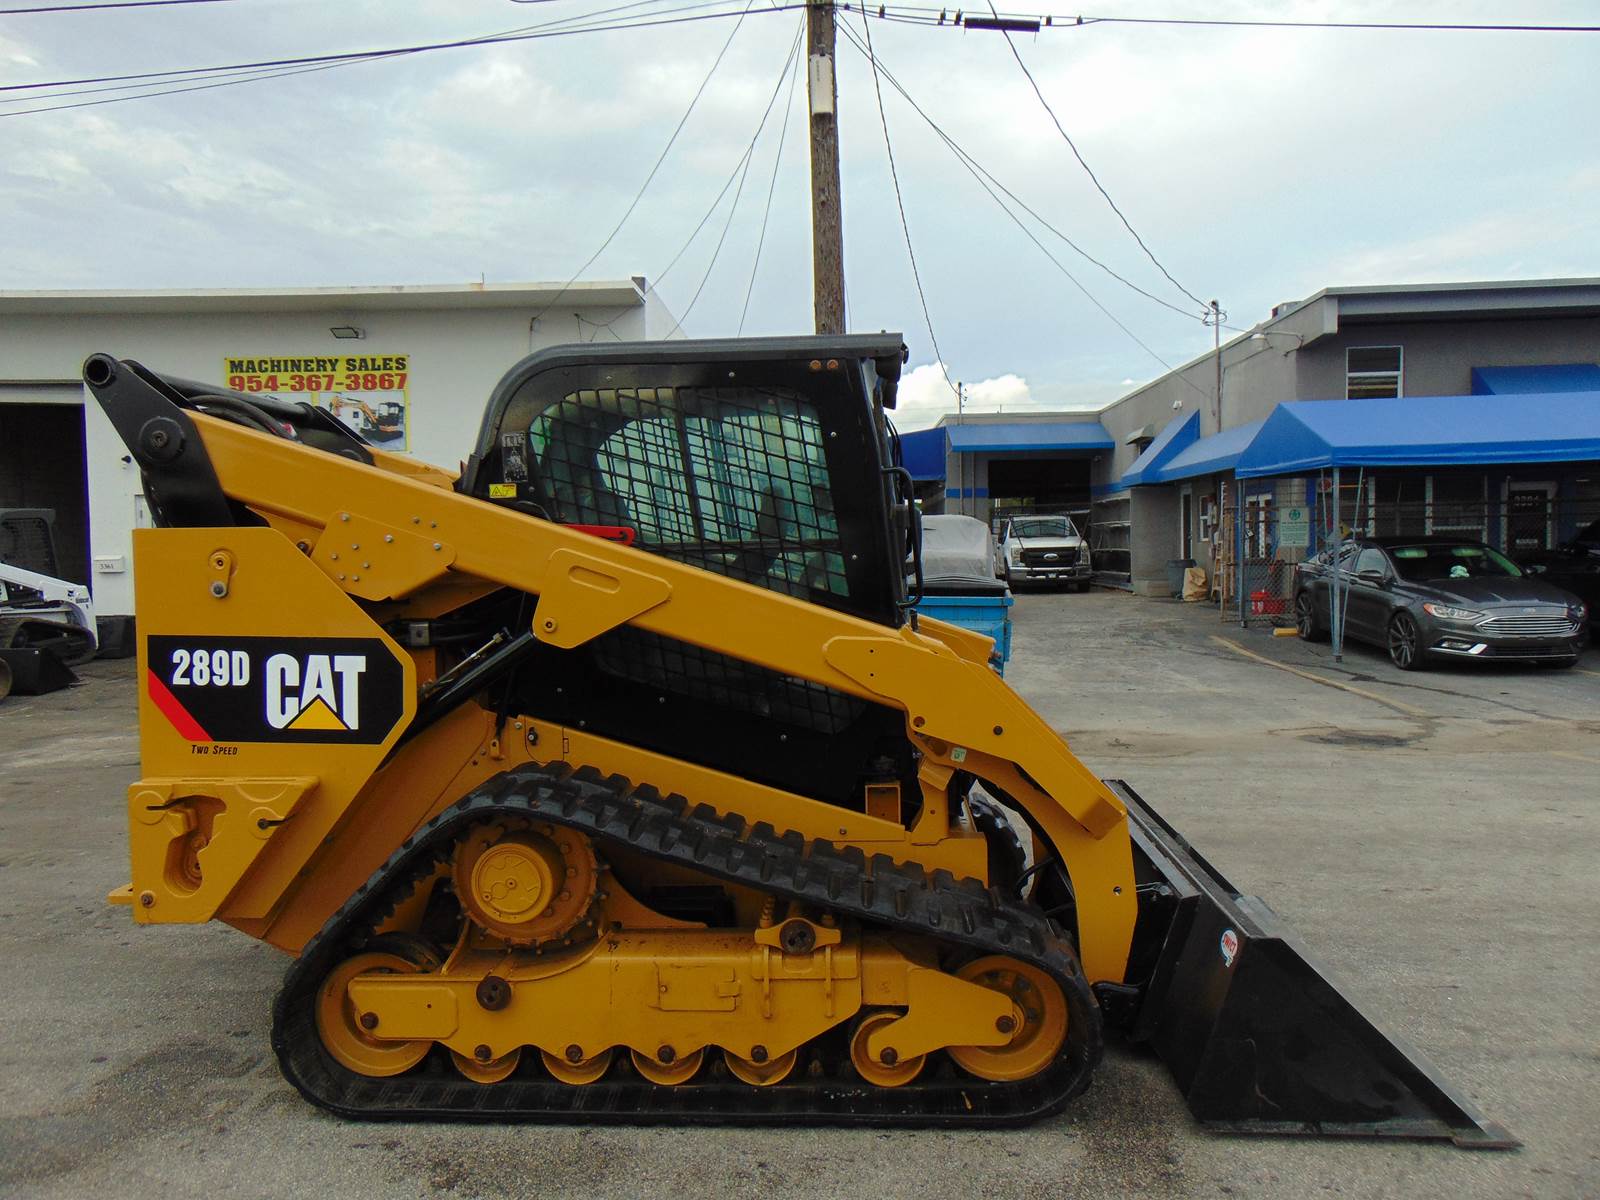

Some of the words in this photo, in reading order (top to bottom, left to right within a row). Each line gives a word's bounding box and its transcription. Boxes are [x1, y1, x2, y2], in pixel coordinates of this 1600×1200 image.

[229, 357, 339, 374] MACHINERY
[345, 356, 407, 372] SALES
[228, 373, 408, 392] 954-367-3867
[172, 648, 250, 687] 289D
[266, 653, 367, 730] CAT
